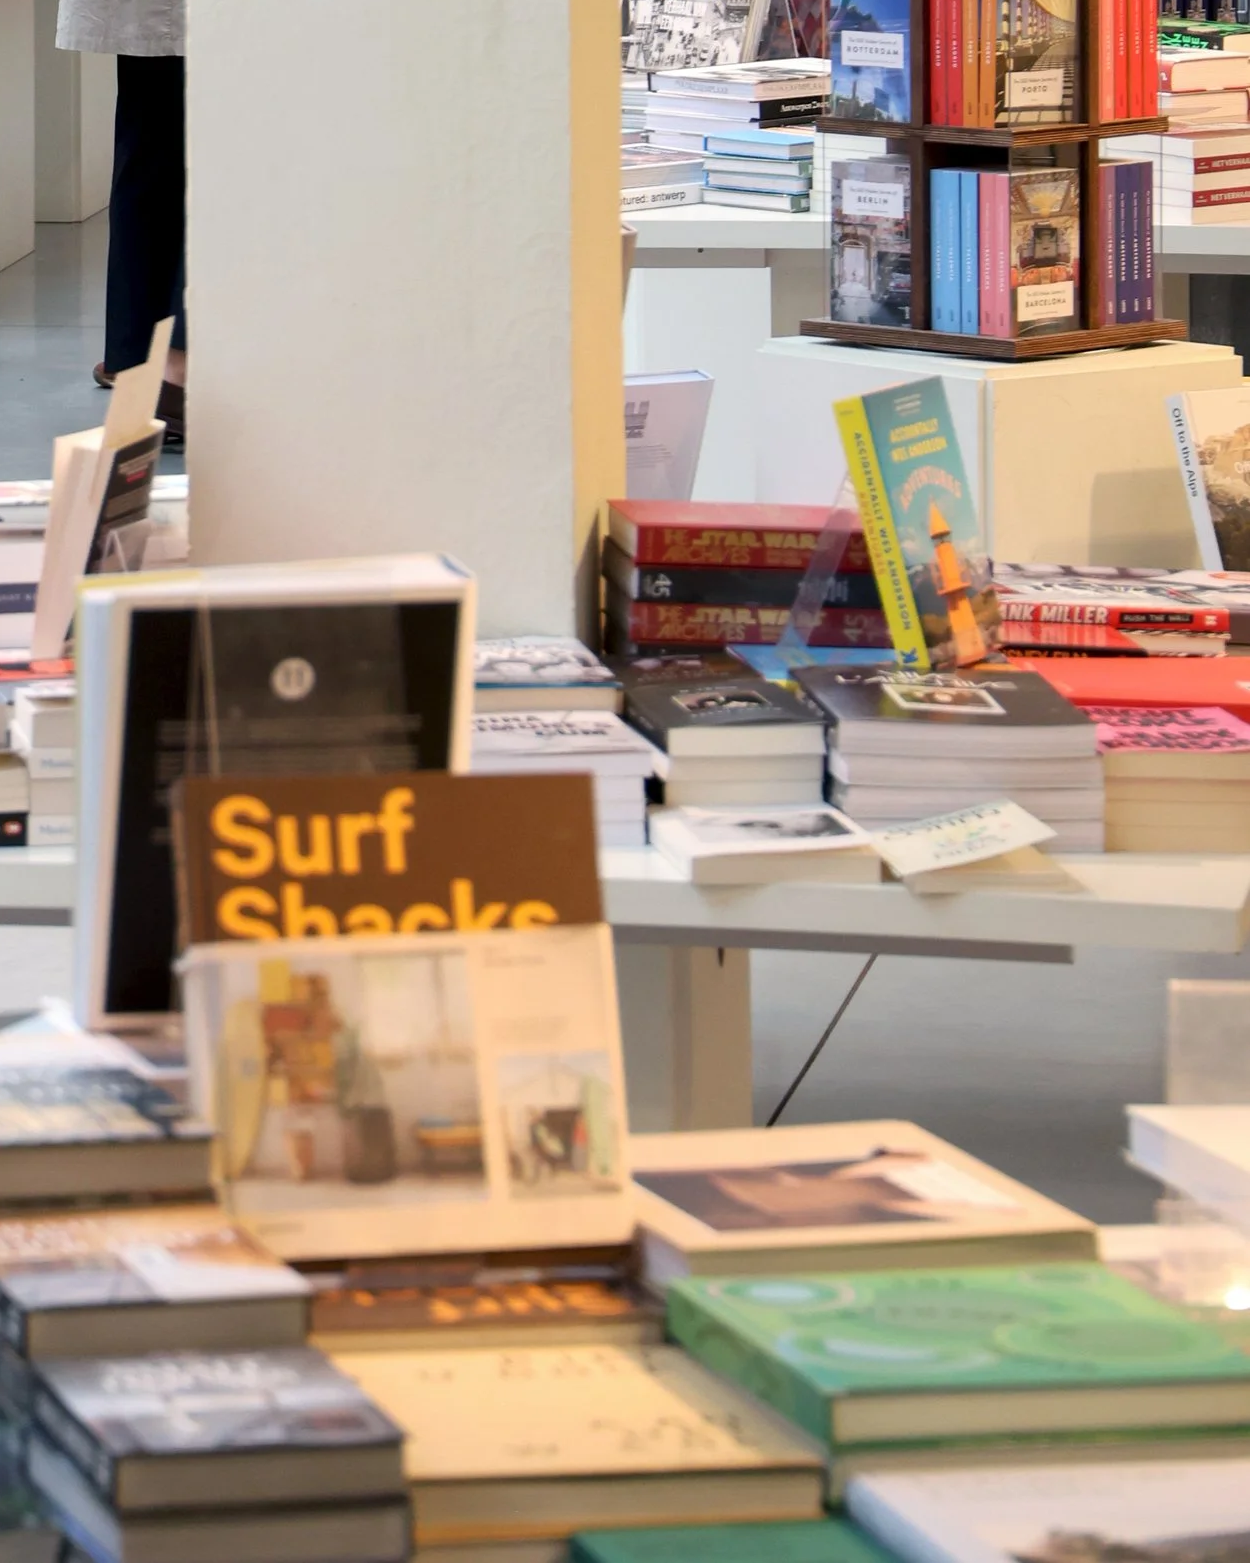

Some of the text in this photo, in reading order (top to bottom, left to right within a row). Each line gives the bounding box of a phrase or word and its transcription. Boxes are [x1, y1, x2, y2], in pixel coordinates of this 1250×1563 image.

[846, 45, 900, 56] ROTTERDAM
[1021, 85, 1048, 94] PORTO
[650, 191, 686, 207] antwerp
[857, 195, 889, 206] BERLIN
[1025, 297, 1067, 309] BARCELONA
[1177, 430, 1186, 444] to
[1181, 446, 1191, 467] the
[1186, 469, 1198, 498] Alps
[692, 530, 762, 547] STAR
[854, 431, 912, 631] ACCIDENTALLY WES ANDERSON
[685, 608, 756, 624] STAR
[1039, 604, 1109, 625] MILLER
[209, 786, 418, 880] Surf
